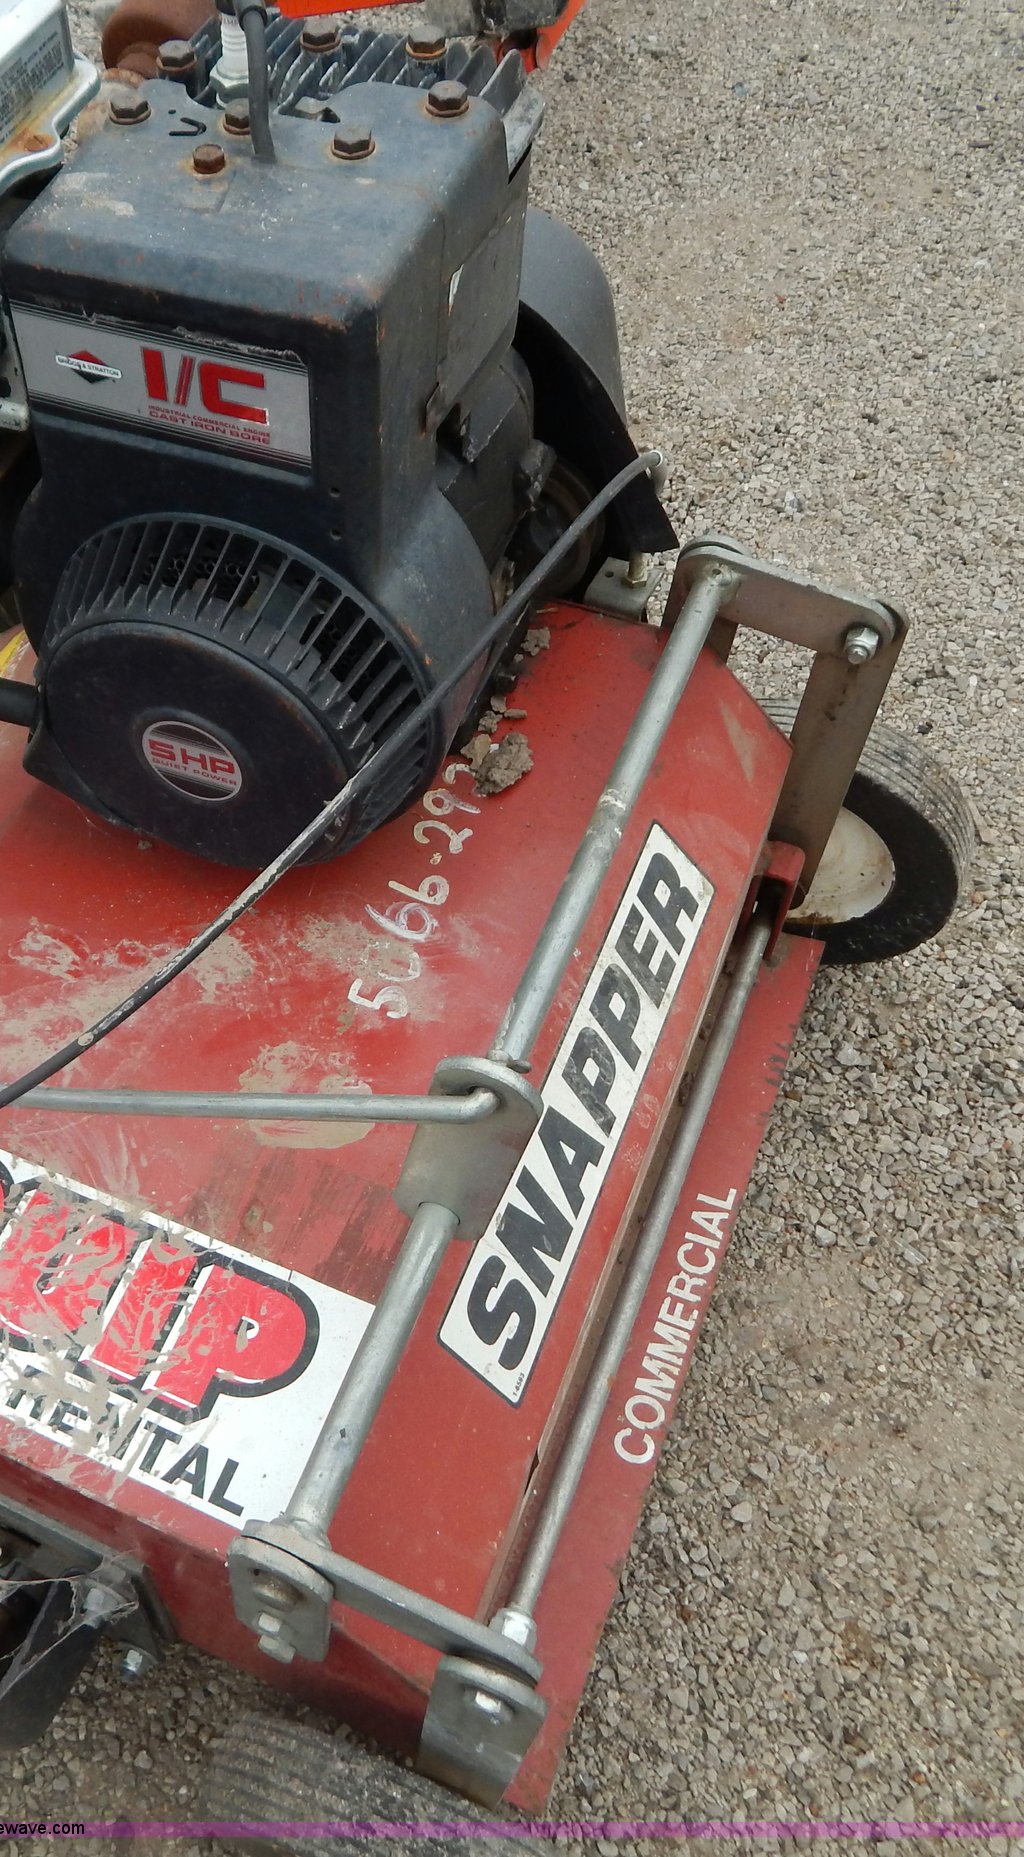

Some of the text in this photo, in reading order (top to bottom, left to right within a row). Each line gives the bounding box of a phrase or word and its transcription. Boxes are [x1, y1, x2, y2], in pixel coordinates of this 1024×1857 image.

[149, 410, 271, 446] CAST IRON BORE
[193, 768, 237, 786] POWER
[467, 852, 700, 1371] SNAPPER
[614, 1188, 737, 1464] COMMERCIAL
